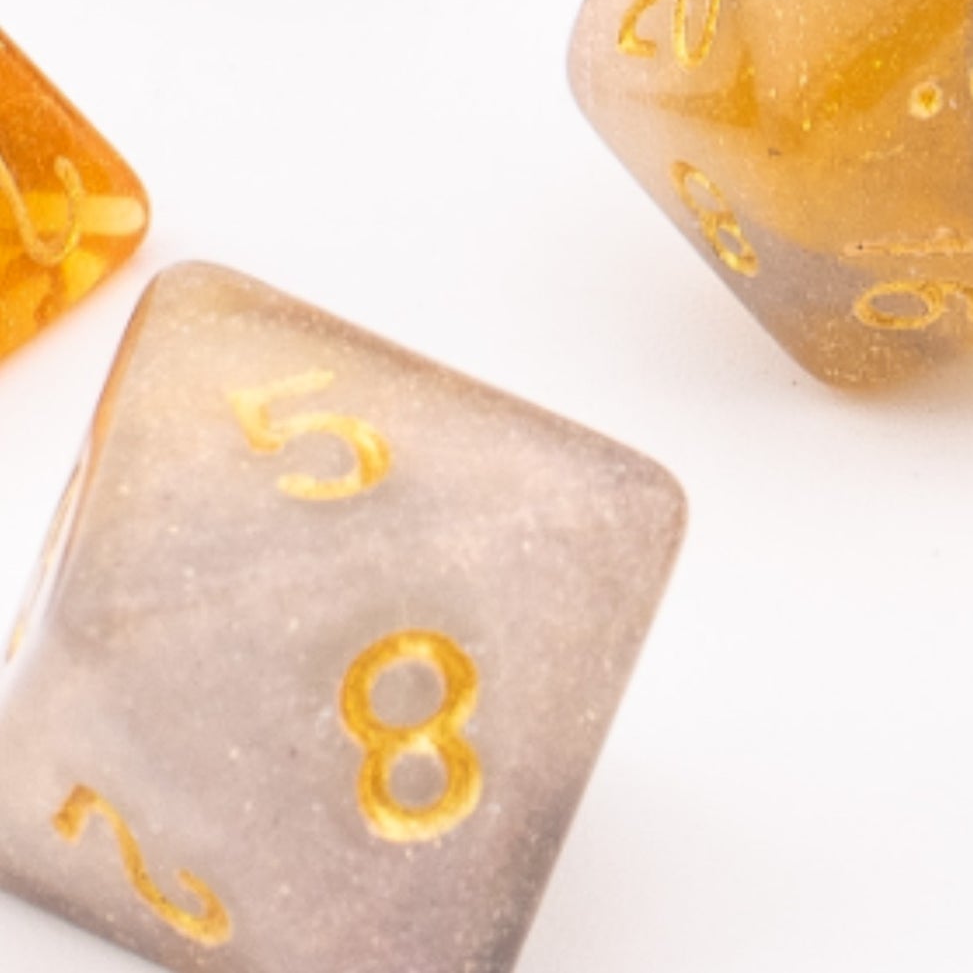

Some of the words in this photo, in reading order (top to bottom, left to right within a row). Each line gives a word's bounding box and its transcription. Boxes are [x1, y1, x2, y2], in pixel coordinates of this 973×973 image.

[671, 159, 760, 279] 8
[226, 369, 393, 502] 5
[338, 627, 484, 843] 8
